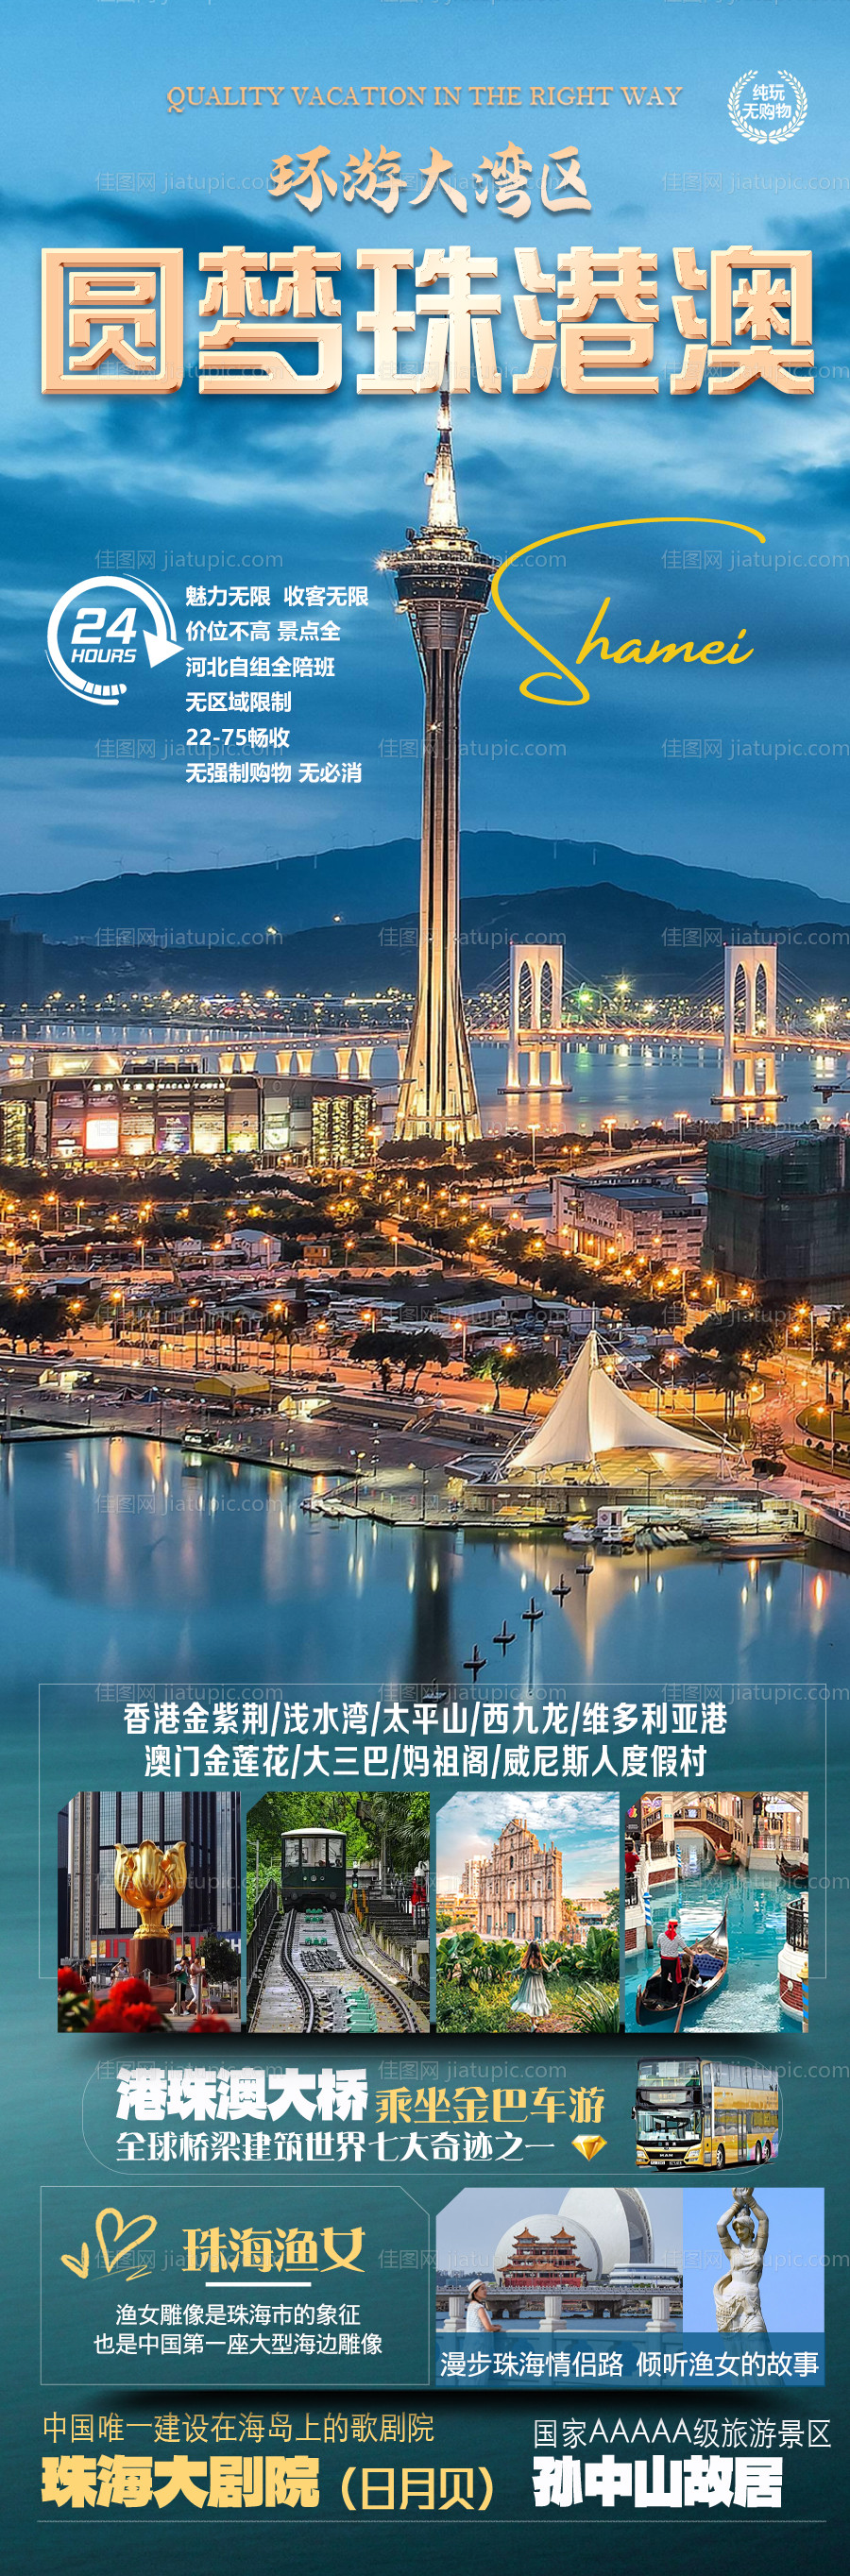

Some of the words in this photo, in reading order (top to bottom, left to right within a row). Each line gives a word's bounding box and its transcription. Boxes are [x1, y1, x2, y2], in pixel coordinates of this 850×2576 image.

[166, 87, 285, 112] QUALITY
[291, 87, 427, 106] VACATION
[434, 87, 462, 106] IN
[468, 87, 522, 106] THE
[529, 87, 614, 106] RIGHT
[620, 87, 683, 106] WAY
[752, 83, 785, 101] 纯玩
[741, 102, 792, 121] 无购物
[268, 141, 592, 218] 环游大湾区
[41, 246, 815, 396] 圆梦珠港澳
[185, 585, 271, 607] 魅力无限
[283, 585, 369, 607] 收客无限
[71, 607, 137, 645] 24
[491, 517, 767, 706] Shamei
[185, 620, 271, 642] 价位不高
[277, 620, 341, 642] 景点全
[71, 649, 137, 663] HOURS
[185, 656, 335, 678] 河北自组全陪班
[185, 691, 292, 713] 无区域限制
[186, 727, 290, 749] 22-75畅收
[185, 762, 292, 784] 无强制购物
[298, 762, 363, 784] 无必消
[124, 1701, 727, 1737] 香港金紫荆/浅水湾/太平山/西九龙/维多利亚港
[144, 1743, 707, 1780] 澳门金莲花/大三巴/妈祖阁/威尼斯人度假村
[115, 2067, 368, 2122] 港珠澳大桥
[375, 2086, 605, 2124] 乘坐金巴车游
[116, 2130, 555, 2162] 全球桥梁建筑世界七大奇迹之一
[181, 2227, 366, 2273] 珠海渔女
[115, 2303, 361, 2326] 渔女雕像是珠海市的象征
[94, 2332, 382, 2355] 也是中国第一座大型海边雕像
[440, 2350, 624, 2378] 漫步珠海情侣路
[636, 2350, 820, 2378] 倾听渔女的故事
[43, 2411, 434, 2444] 中国唯一建设在海岛上的歌剧院
[534, 2416, 832, 2449] 国家AAAAA级旅游景区
[41, 2454, 320, 2509] 珠海大剧院
[532, 2454, 783, 2508] 孙中山故居
